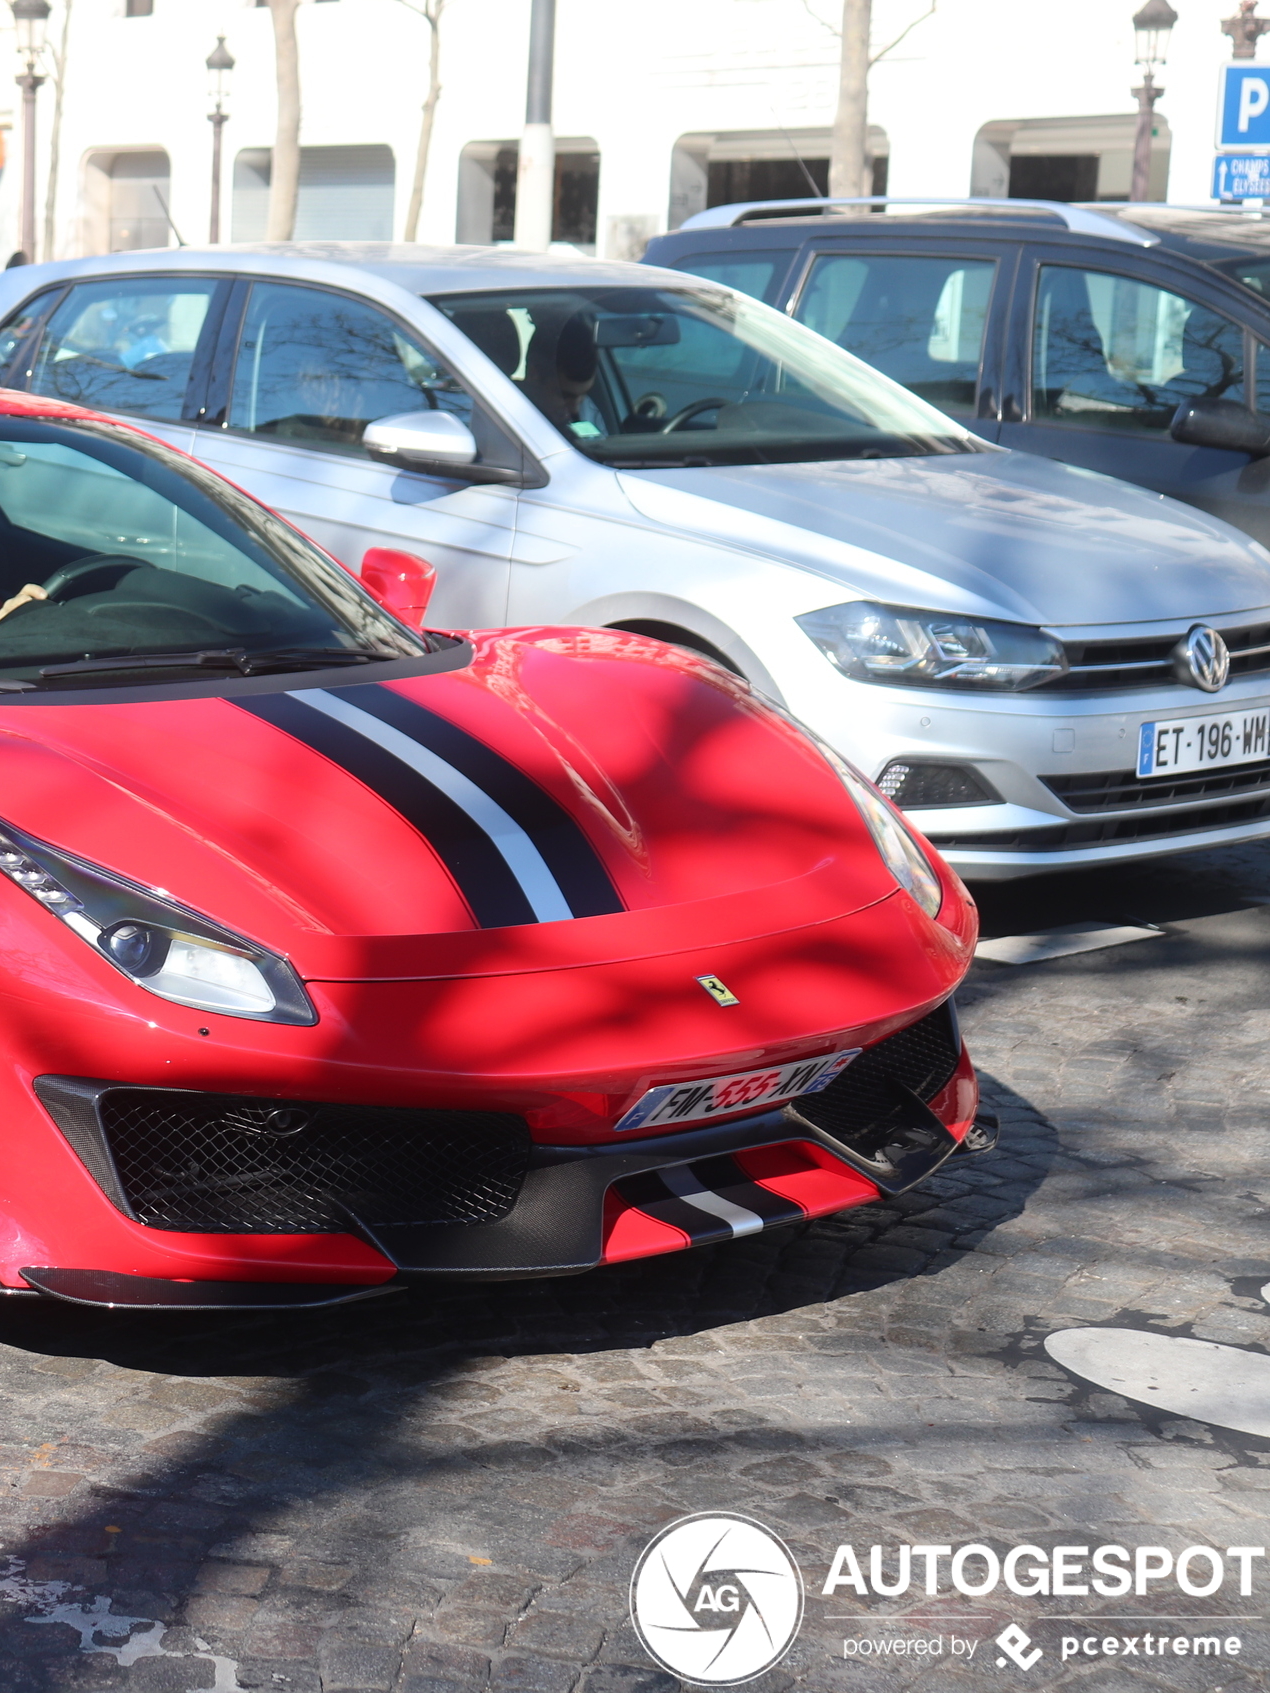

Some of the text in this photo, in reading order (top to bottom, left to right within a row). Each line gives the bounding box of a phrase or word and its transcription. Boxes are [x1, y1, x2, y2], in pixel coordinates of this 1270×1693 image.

[1238, 77, 1270, 133] P
[1231, 159, 1270, 176] CHAMPS
[651, 1060, 828, 1121] FM-555-XN
